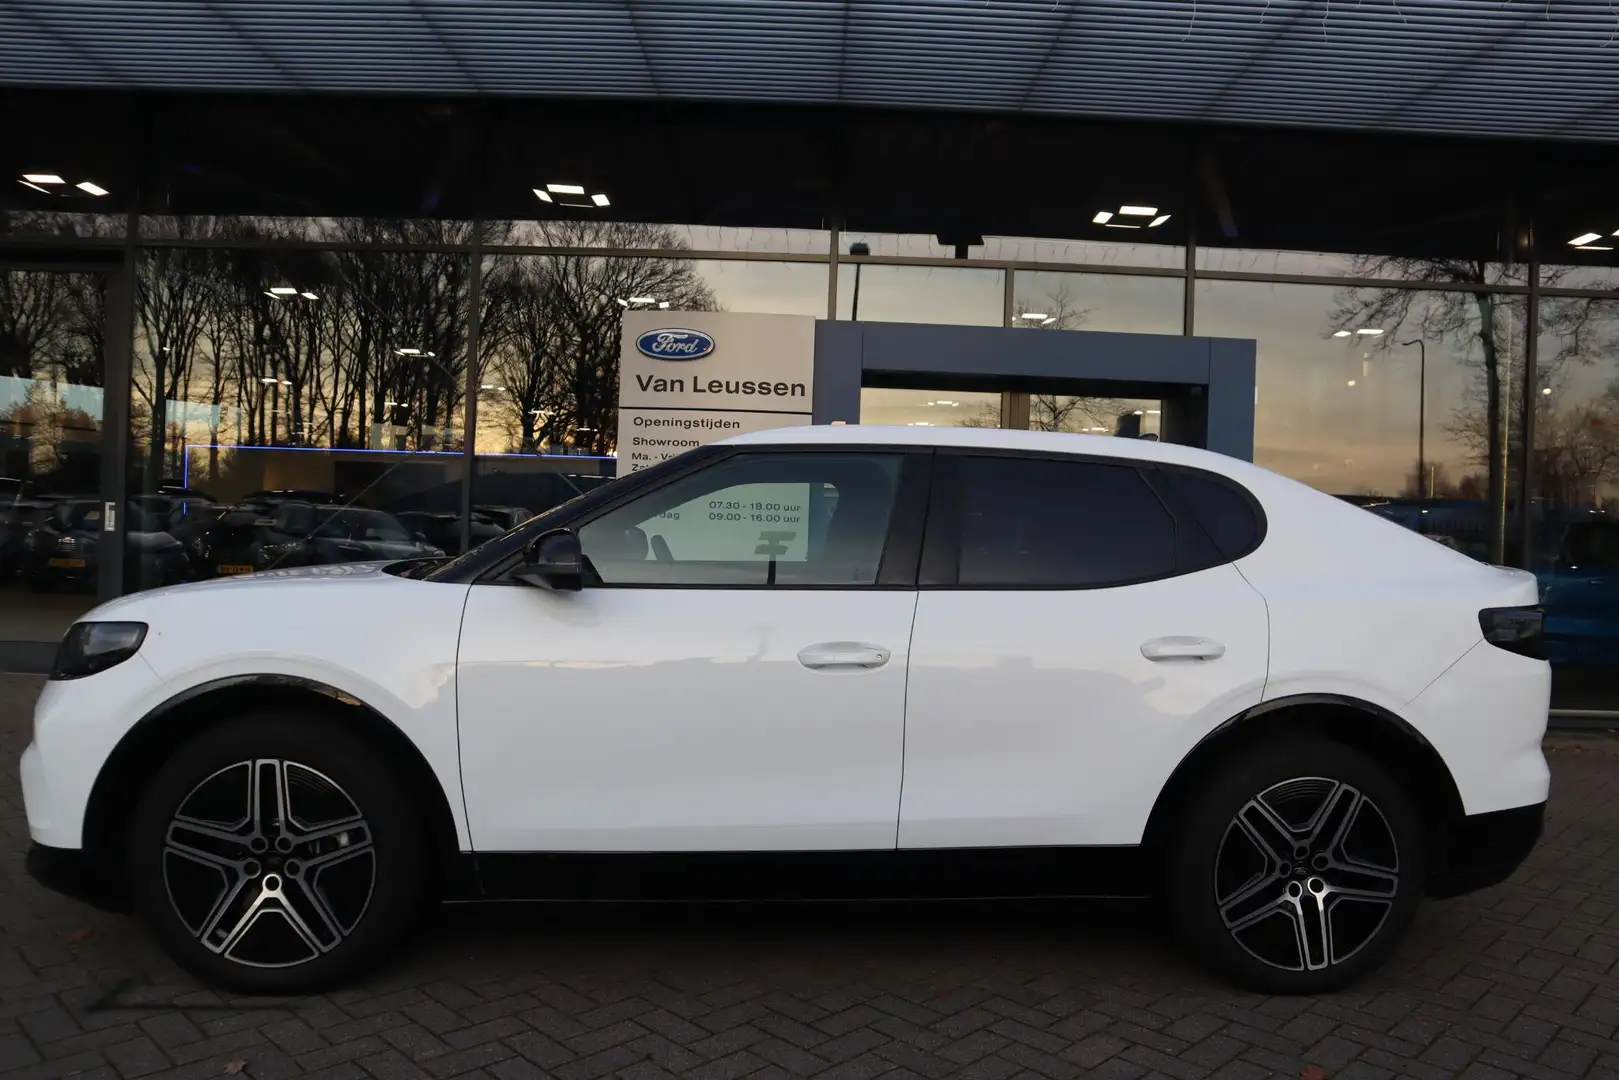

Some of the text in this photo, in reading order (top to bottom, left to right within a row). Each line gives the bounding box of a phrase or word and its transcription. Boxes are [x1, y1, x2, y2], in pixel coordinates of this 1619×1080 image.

[636, 374, 806, 397] Van Leussen
[633, 416, 741, 430] Openingstijden
[632, 437, 700, 448] Showroom
[631, 452, 651, 460] Ma.
